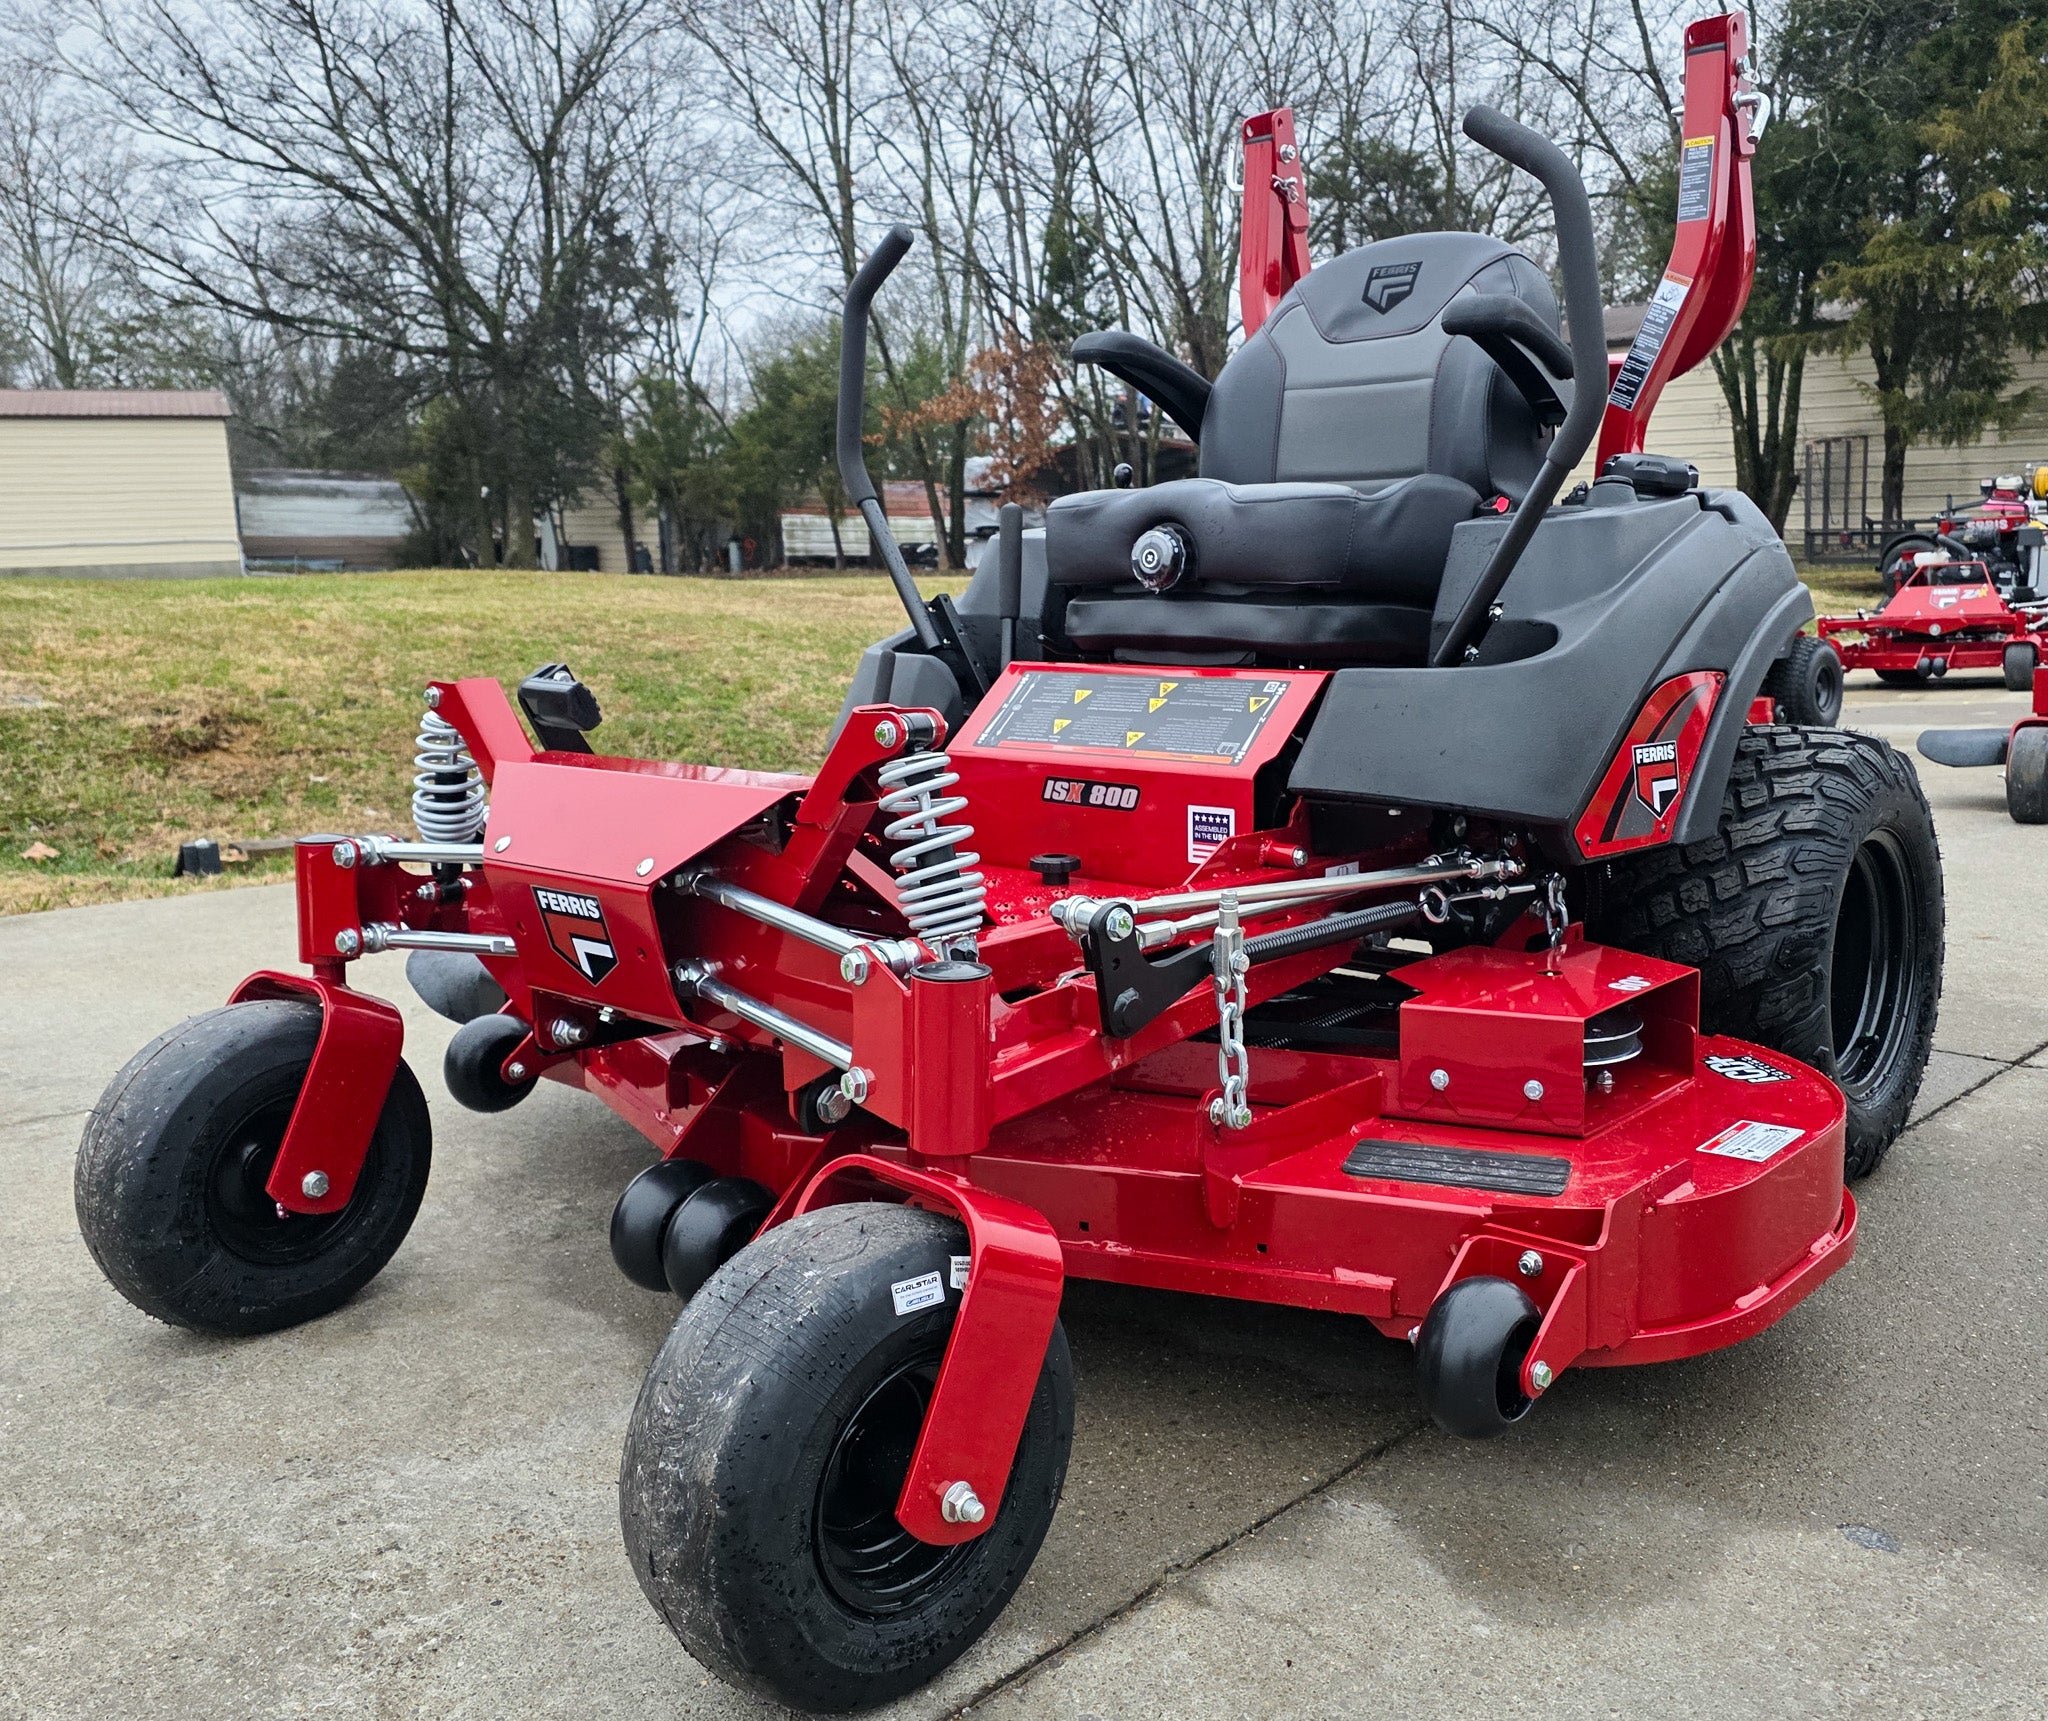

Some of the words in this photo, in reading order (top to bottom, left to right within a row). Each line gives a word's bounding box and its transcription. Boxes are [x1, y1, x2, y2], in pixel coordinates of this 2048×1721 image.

[1690, 138, 1713, 146] CAUTION
[1372, 264, 1418, 278] FERRIS
[1635, 744, 1675, 764] FERRIS
[1043, 779, 1085, 804] ISX
[1089, 784, 1139, 809] 800
[1194, 825, 1228, 834] ASSEMBLED
[1212, 833, 1228, 842] USA
[536, 890, 600, 919] FERRIS
[894, 1276, 938, 1294] CARLSTAR
